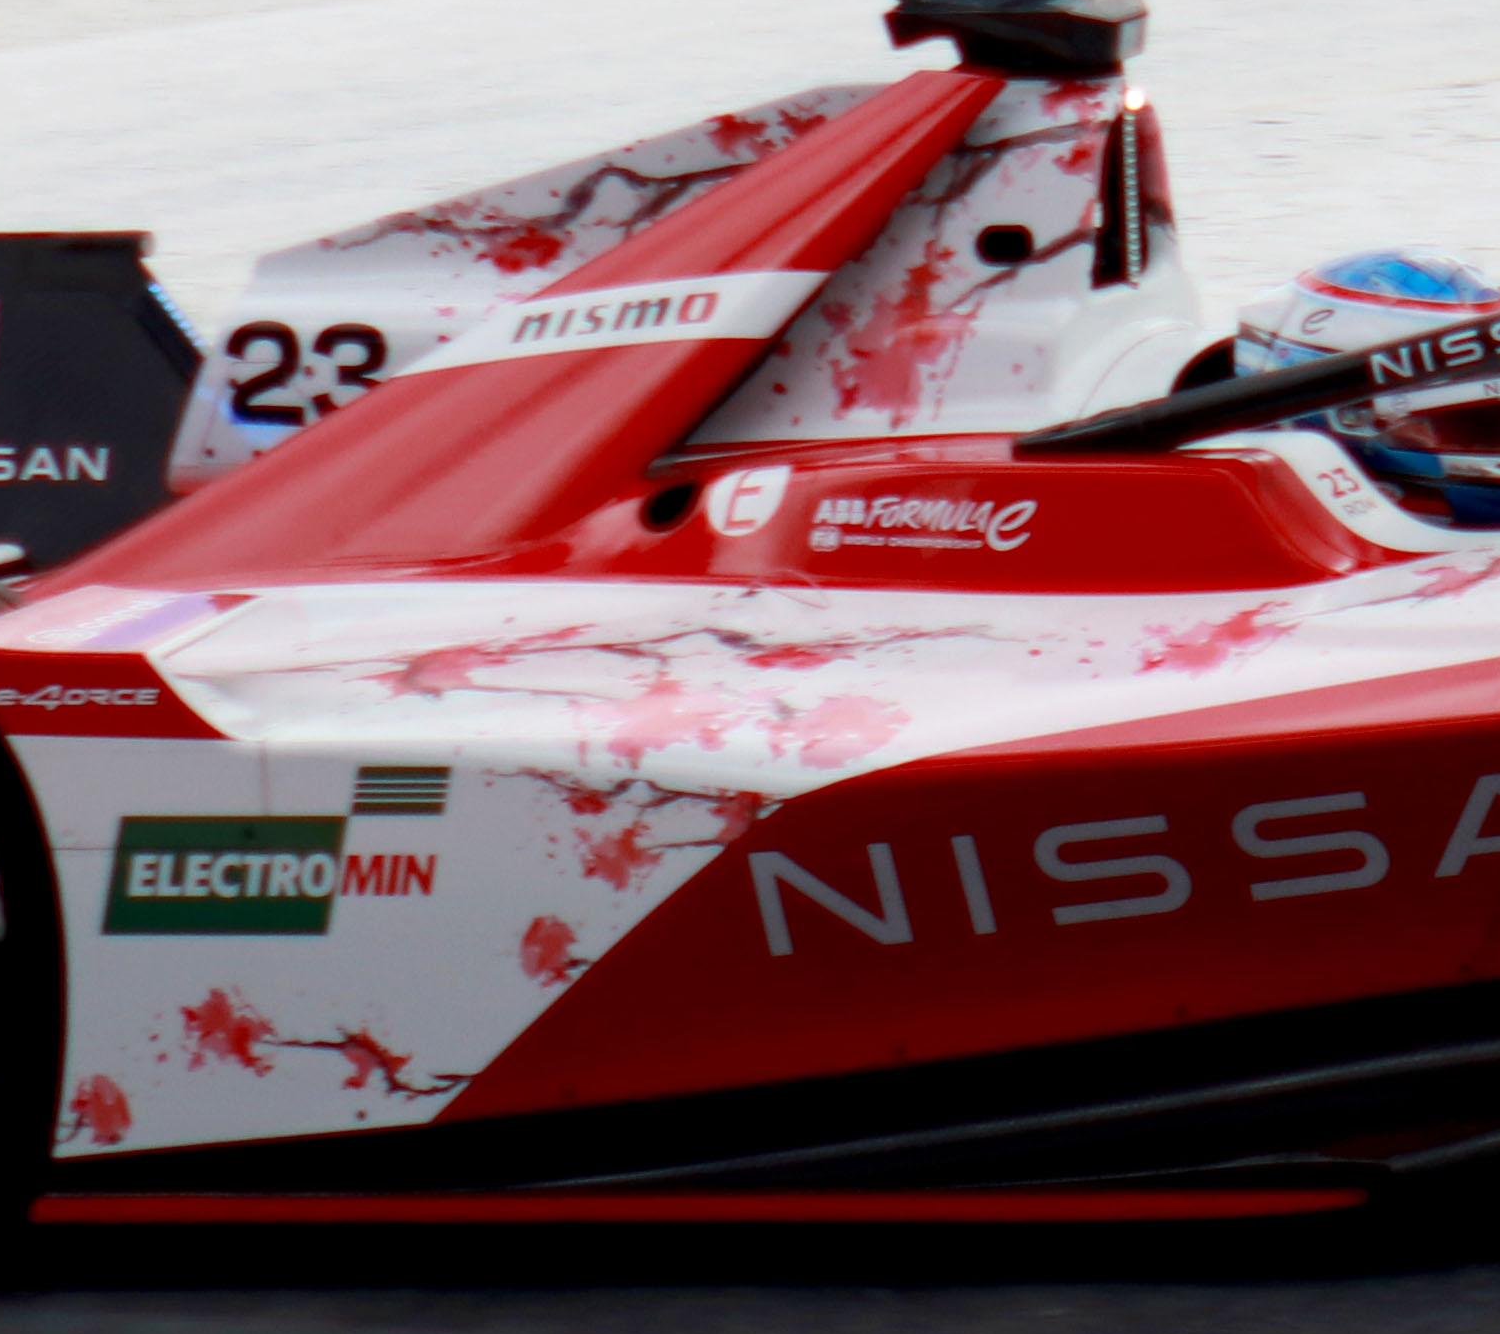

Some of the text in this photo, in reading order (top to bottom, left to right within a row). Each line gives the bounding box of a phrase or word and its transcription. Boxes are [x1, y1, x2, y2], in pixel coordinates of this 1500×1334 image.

[511, 291, 720, 343] nismo
[226, 320, 388, 427] 23
[1316, 466, 1361, 499] 23
[812, 498, 868, 525] ABB
[127, 853, 437, 898] ELECTROMIN
